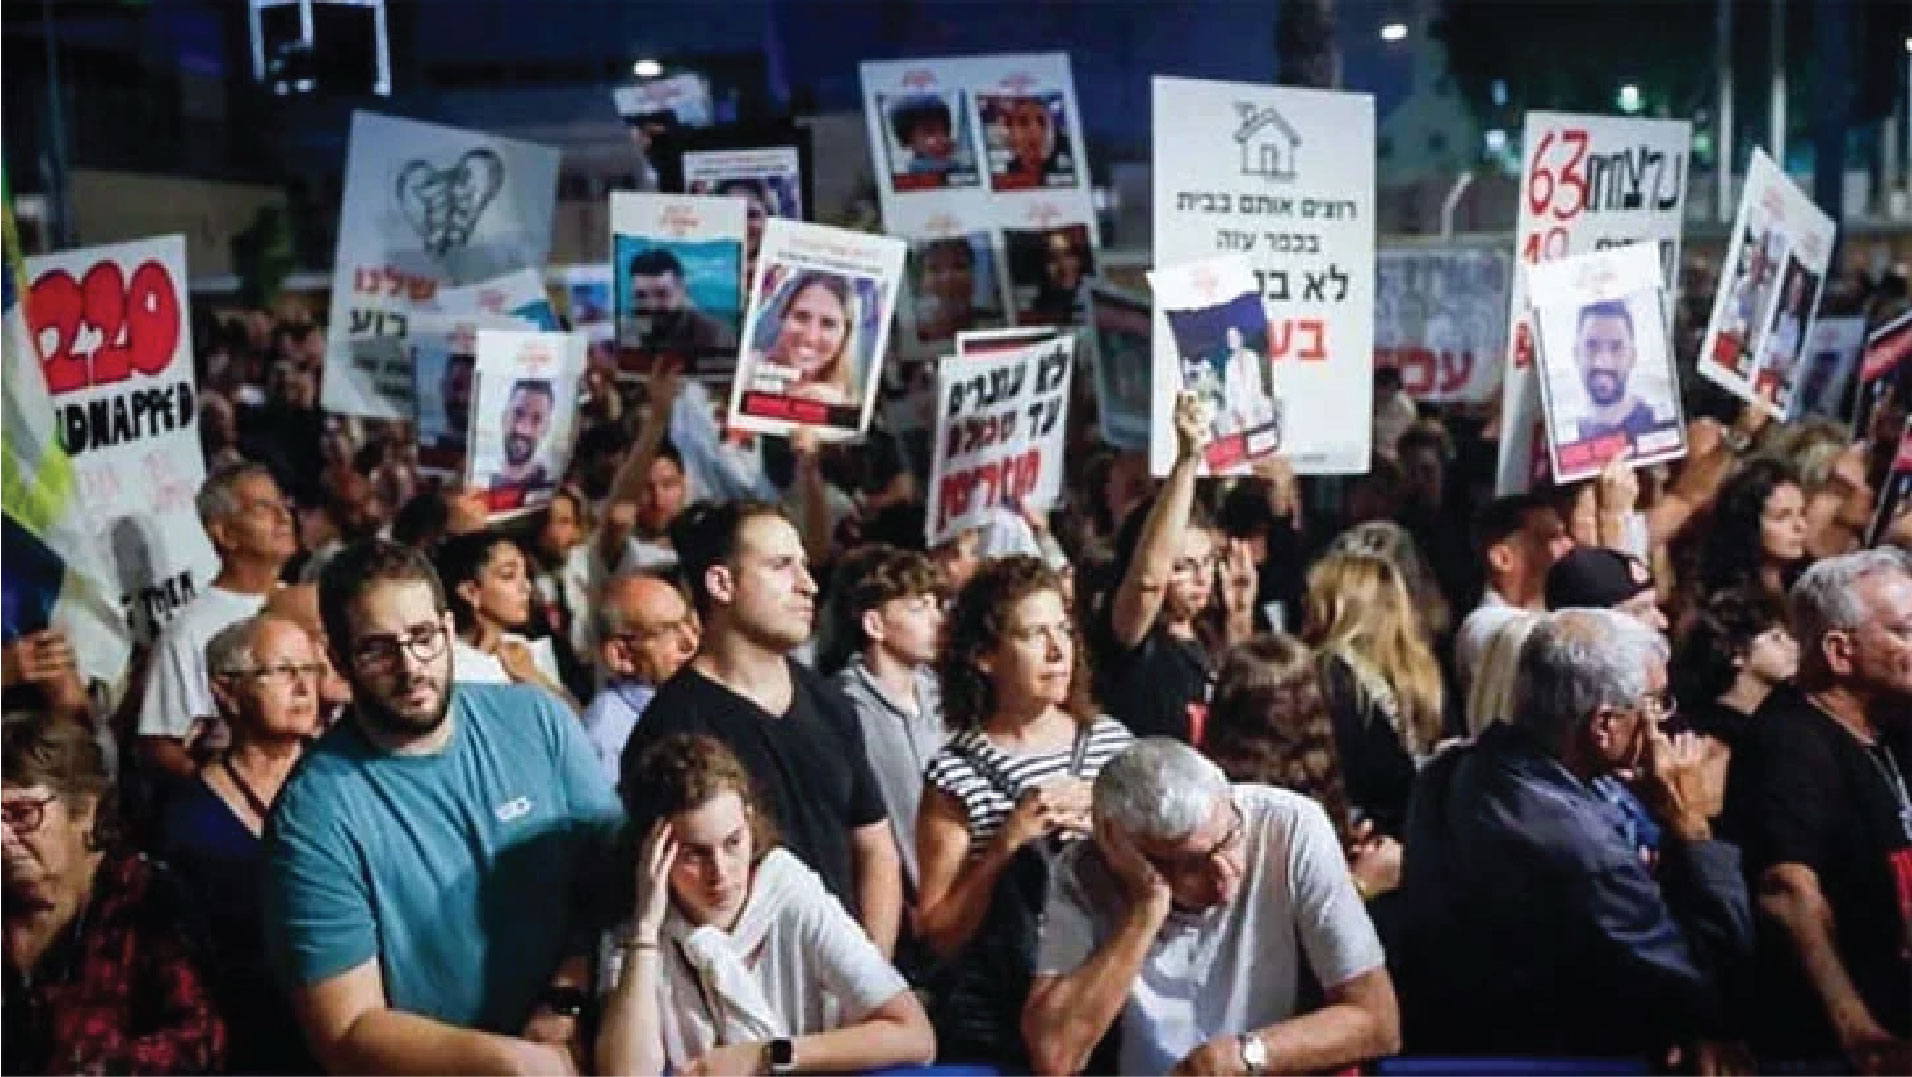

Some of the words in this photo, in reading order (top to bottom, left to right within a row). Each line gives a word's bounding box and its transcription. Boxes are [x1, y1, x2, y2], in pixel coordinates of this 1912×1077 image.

[1529, 129, 1590, 221] 63
[1177, 191, 1232, 213] בבית
[1302, 197, 1358, 221] רוצים
[1303, 264, 1350, 302] לא
[26, 260, 181, 396] 220
[1268, 319, 1328, 361] בע
[55, 381, 195, 458] IDNAPPED
